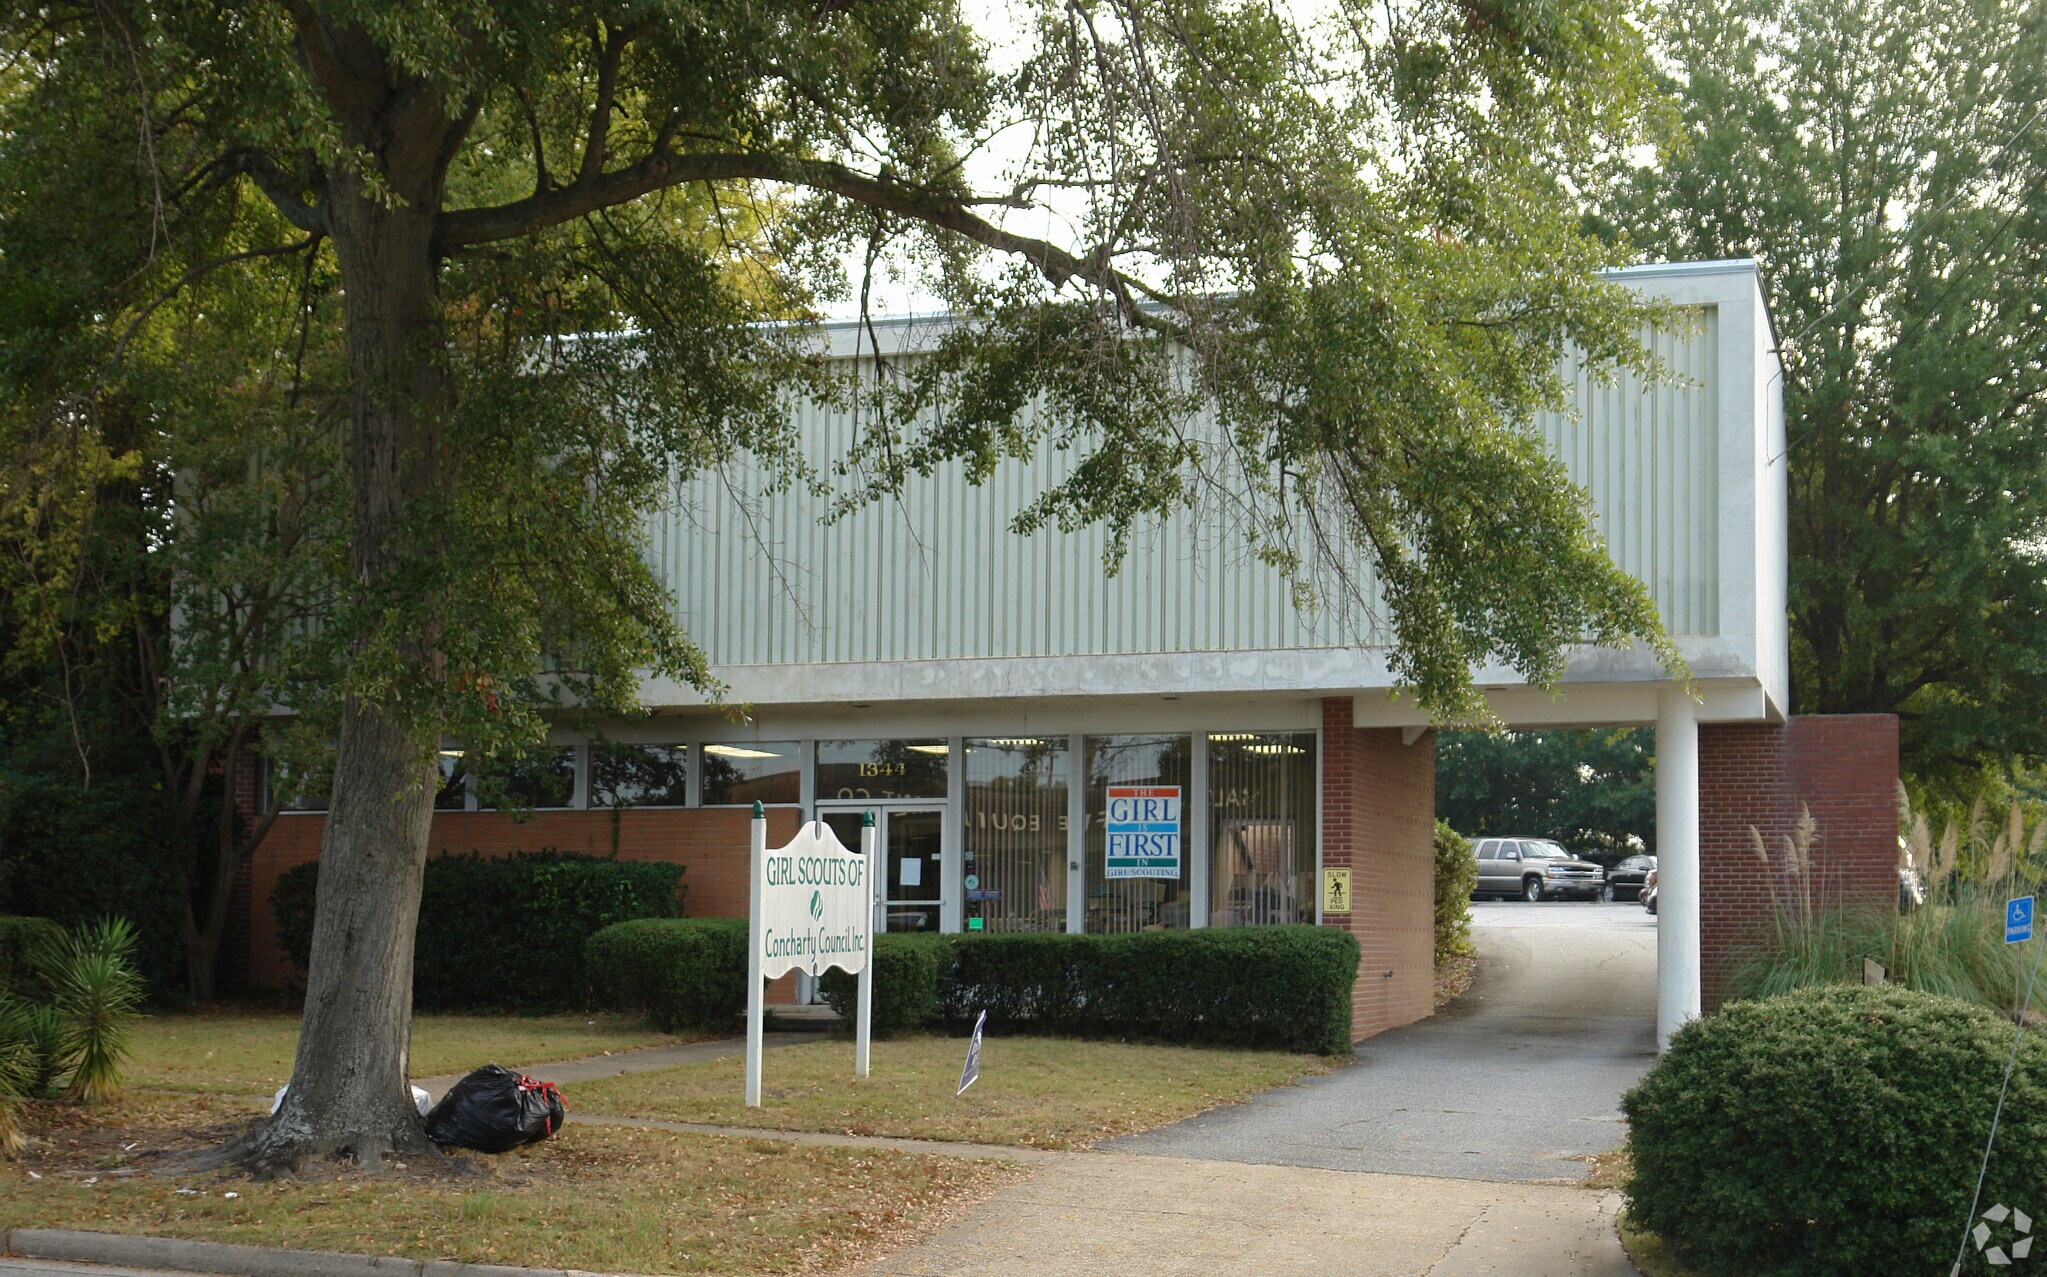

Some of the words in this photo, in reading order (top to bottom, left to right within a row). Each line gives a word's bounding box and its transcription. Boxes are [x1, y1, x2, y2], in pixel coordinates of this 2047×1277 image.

[858, 762, 906, 777] 1344
[1134, 788, 1155, 797] THE
[1110, 798, 1177, 822] GIRL
[1138, 824, 1148, 832] IS
[1108, 833, 1178, 856] FIRST
[1136, 858, 1149, 867] IN
[766, 856, 796, 886] GIRL
[798, 856, 846, 886] SCOUTS
[848, 859, 865, 886] OF
[1107, 868, 1129, 877] GIRL
[1131, 868, 1178, 877] SCOUTING
[765, 927, 817, 962] Concharty
